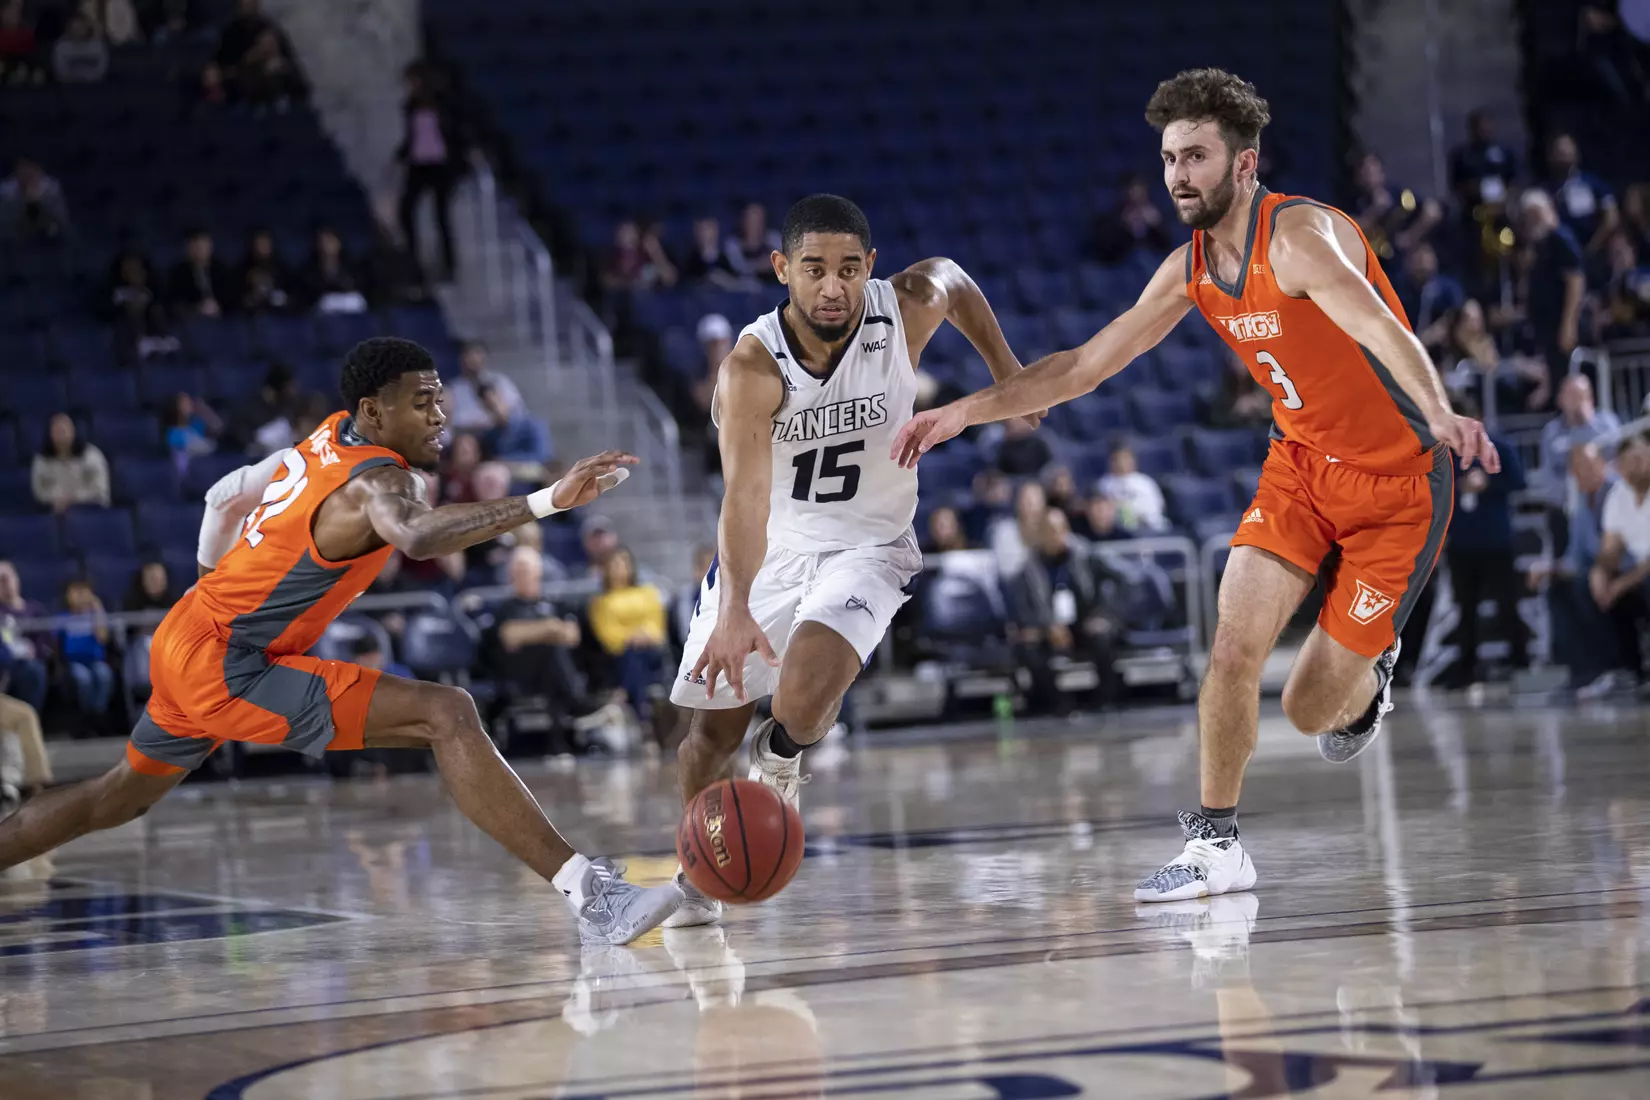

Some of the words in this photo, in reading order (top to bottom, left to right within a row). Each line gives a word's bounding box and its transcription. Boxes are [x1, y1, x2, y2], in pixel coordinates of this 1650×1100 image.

[862, 338, 887, 353] WAC
[1256, 350, 1304, 411] 3
[771, 392, 888, 444] LANCERS
[791, 439, 865, 503] 15
